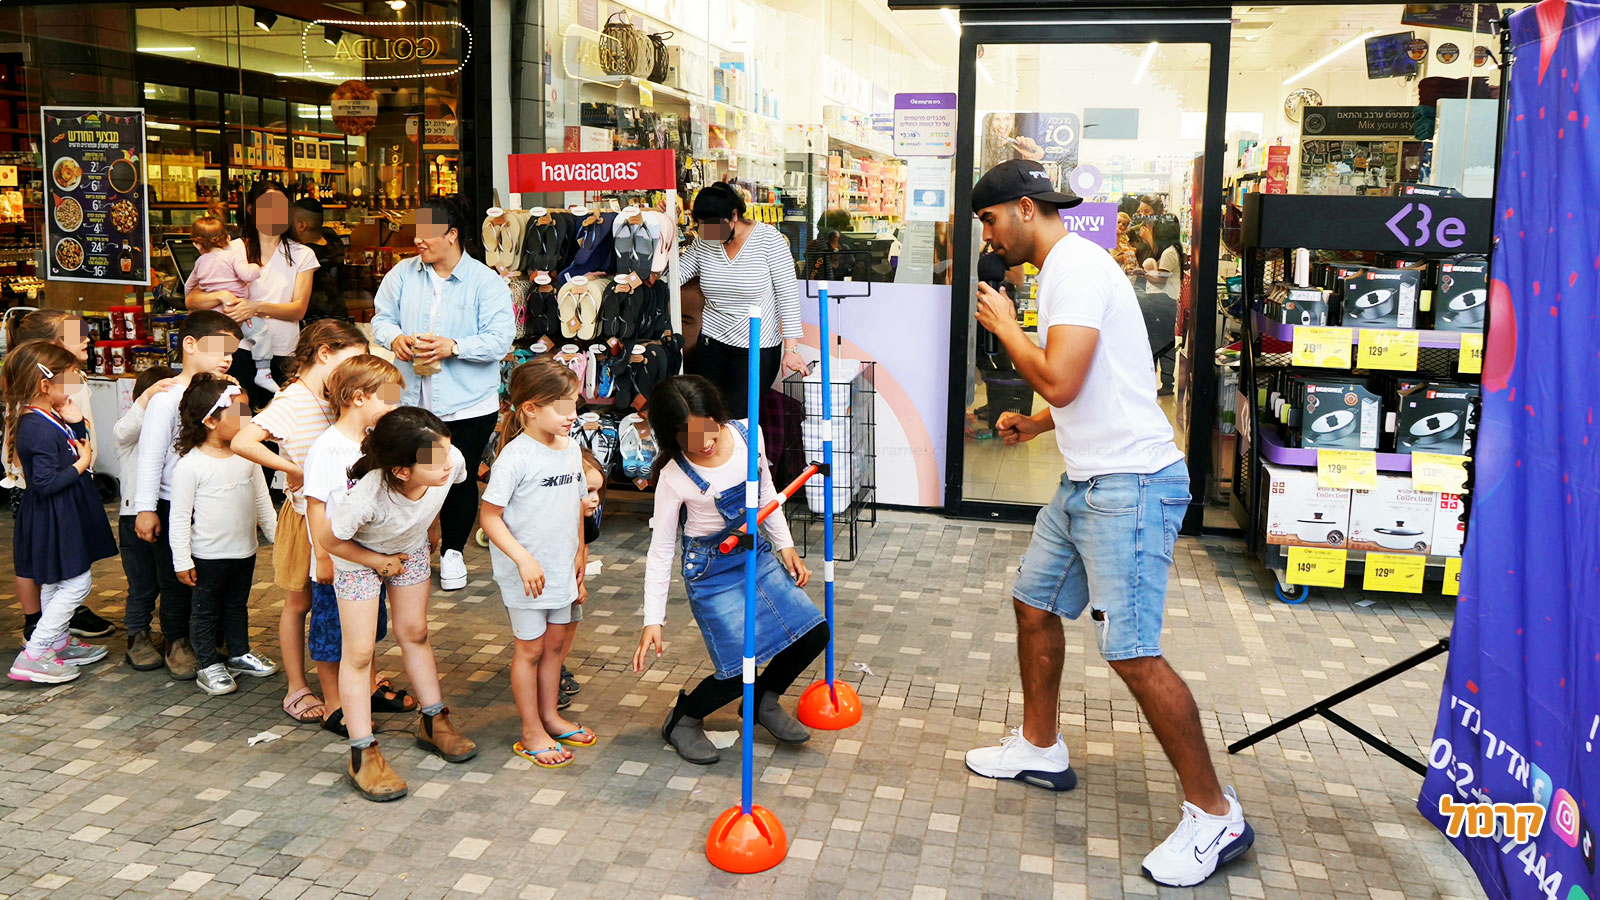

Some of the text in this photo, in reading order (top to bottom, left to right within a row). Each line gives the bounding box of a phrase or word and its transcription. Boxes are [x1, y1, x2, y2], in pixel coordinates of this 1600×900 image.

[1364, 111, 1384, 119] ערבב
[1385, 111, 1410, 119] מצעים
[1358, 120, 1415, 131] Mix your sty
[67, 130, 119, 143] מבצעי החודש
[1044, 125, 1075, 146] iO
[541, 161, 638, 182] havaianas
[1063, 215, 1105, 232] יציאה
[1396, 493, 1433, 502] Collection
[1483, 729, 1531, 789] אדיר
